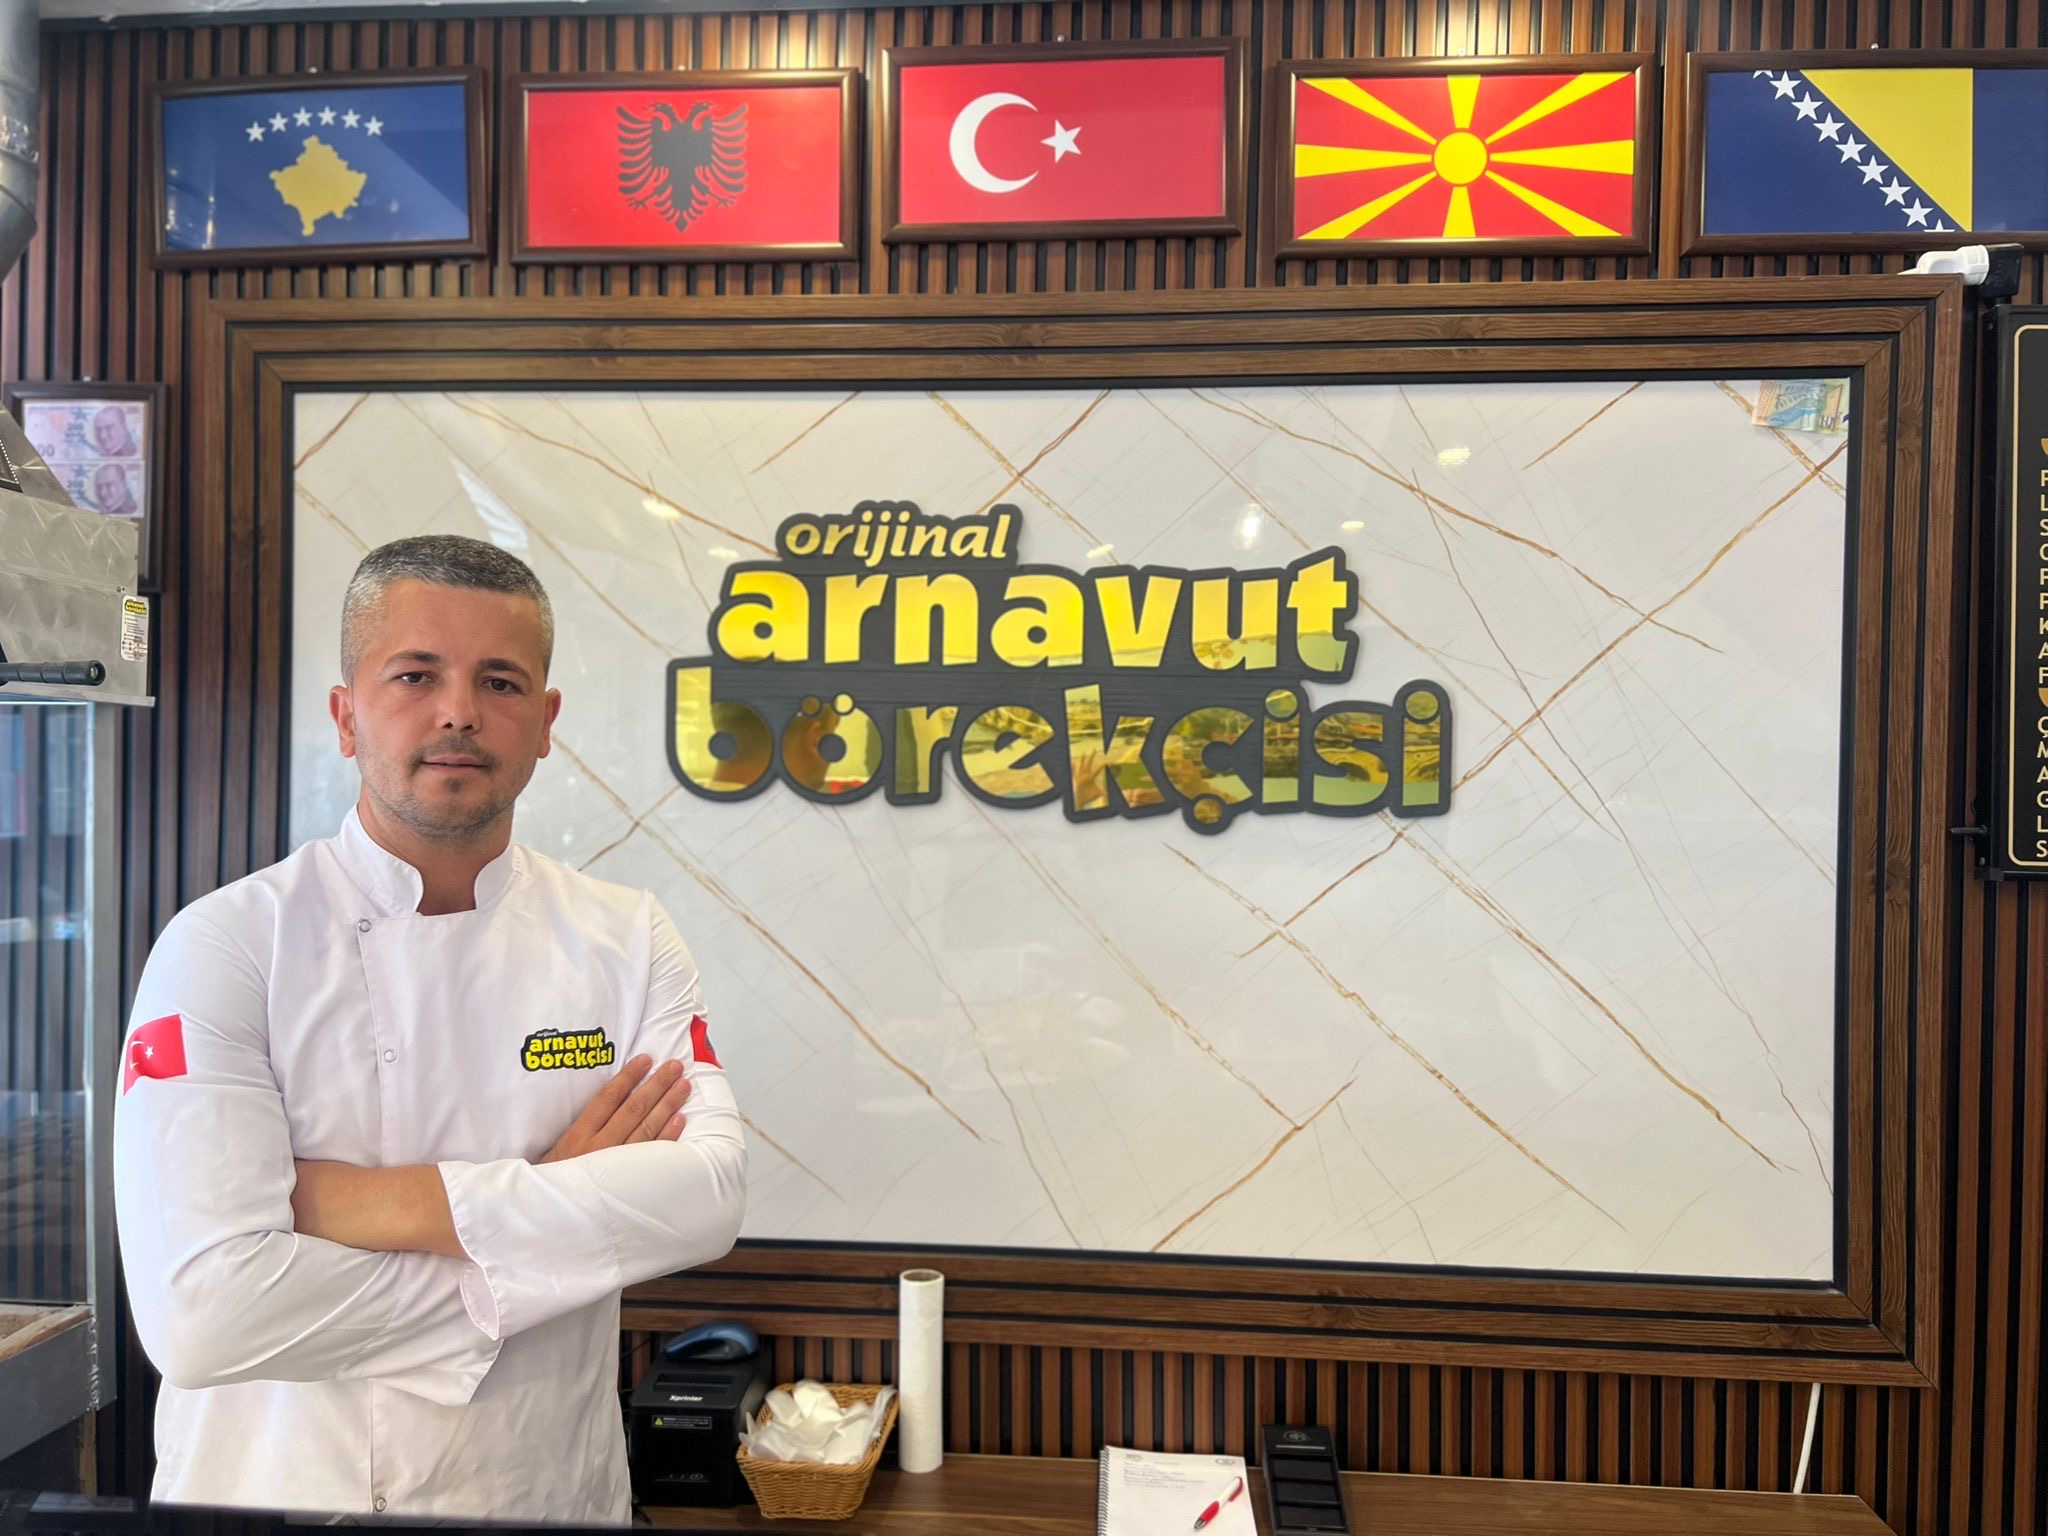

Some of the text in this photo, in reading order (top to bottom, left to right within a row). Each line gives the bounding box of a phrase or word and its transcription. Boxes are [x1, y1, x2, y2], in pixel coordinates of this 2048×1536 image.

[785, 510, 1011, 567] orijinal
[716, 556, 1349, 672] arnavut
[675, 664, 1442, 825] börekçisi
[525, 1046, 613, 1070] börekçisi
[529, 1032, 604, 1053] arnavut
[668, 1394, 704, 1402] Xprinter
